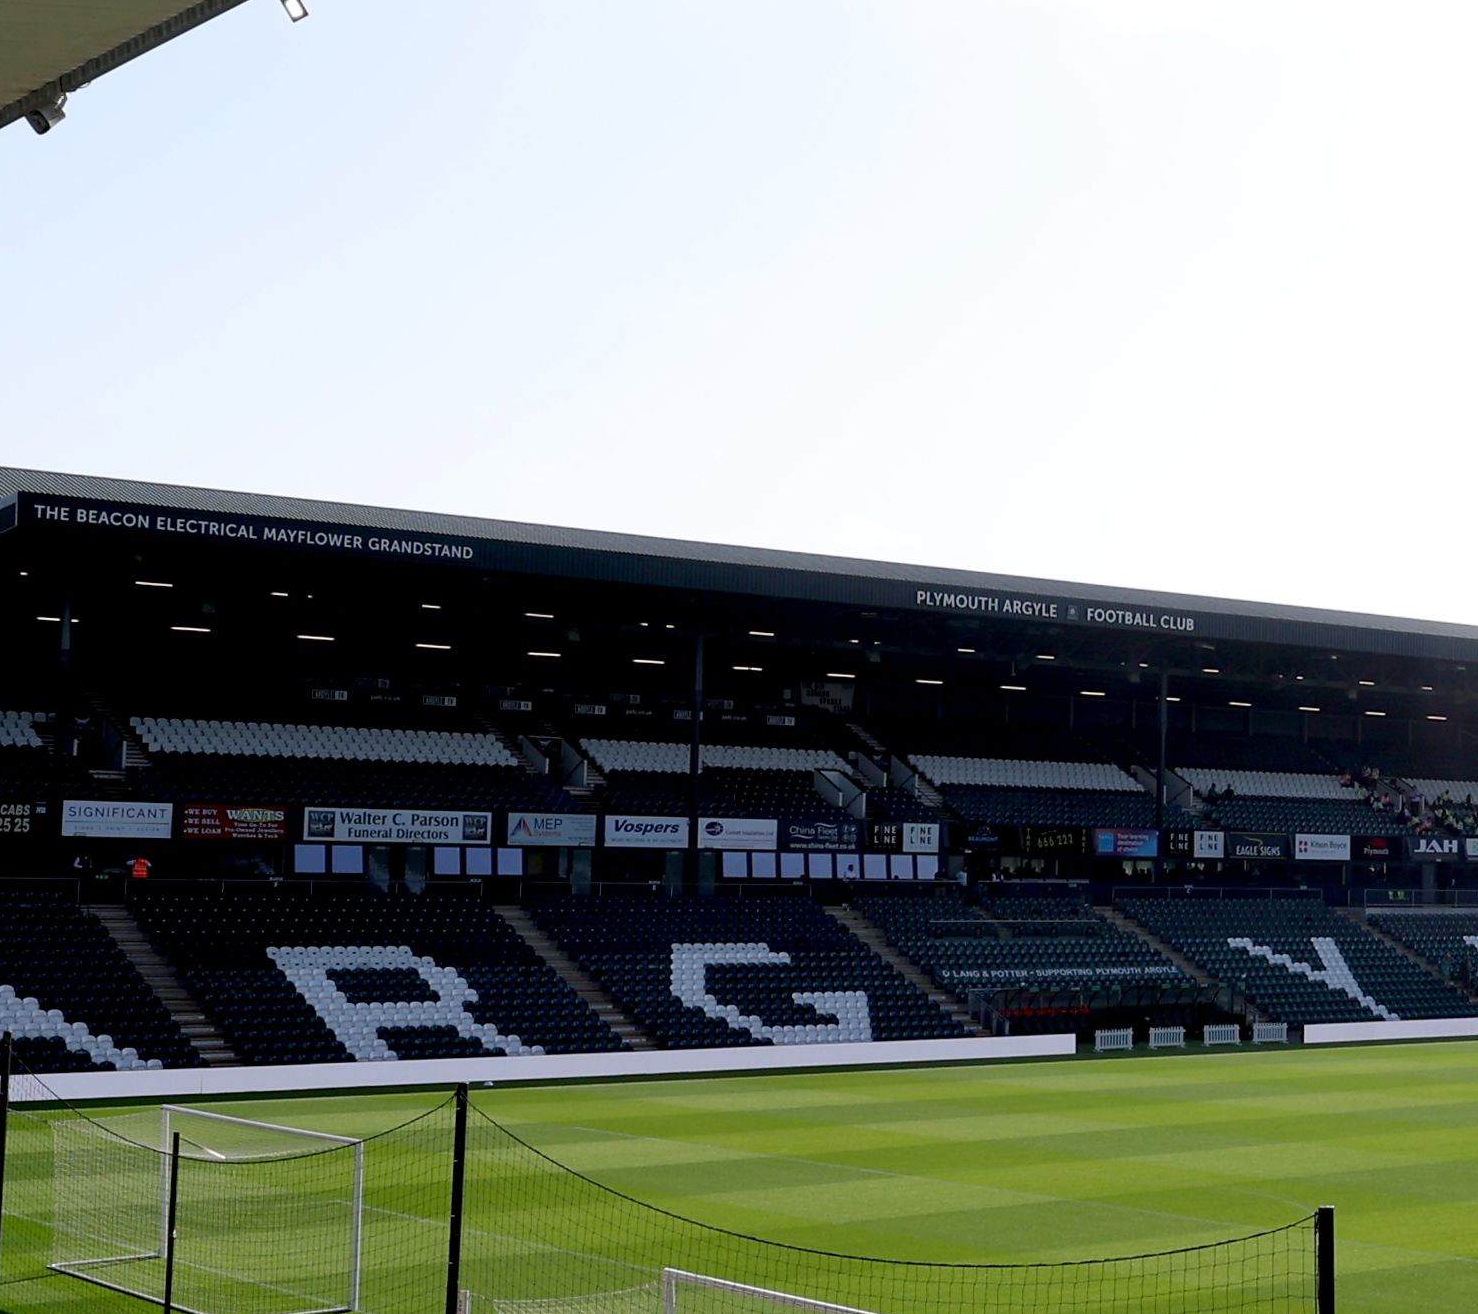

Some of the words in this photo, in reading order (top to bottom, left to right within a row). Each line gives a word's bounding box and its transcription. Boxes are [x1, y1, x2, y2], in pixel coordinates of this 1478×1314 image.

[34, 504, 70, 521] THE
[76, 508, 150, 529] BEACON
[156, 516, 257, 540] ELECTRICAL
[263, 527, 363, 550] MAYFLOWER
[368, 537, 474, 560] GRANDSTAND
[916, 590, 999, 611] PLYMOUTH
[1003, 600, 1058, 618] ARGYLE
[1086, 607, 1156, 628] FOOTBALL
[1160, 616, 1194, 631] CLUB
[0, 803, 31, 816] CABS
[68, 806, 167, 819] SIGNIFICANT
[226, 809, 285, 821] WANTS
[13, 817, 30, 833] 25
[339, 812, 388, 826] Walter
[393, 813, 406, 826] C.
[411, 814, 459, 827] Parson
[534, 818, 562, 830] MEP
[613, 820, 679, 835] Vospers
[789, 825, 816, 835] China
[817, 826, 838, 835] Fleet
[348, 828, 391, 839] Funeral
[396, 828, 449, 840] Directors
[1236, 846, 1258, 856] EAGLE
[1260, 846, 1280, 856] SIGNS
[1311, 841, 1328, 849] Kitson
[1330, 842, 1347, 850] Boyce
[1414, 839, 1458, 853] JAH
[1364, 848, 1389, 856] Plymouth
[953, 970, 979, 978] LANG
[1036, 968, 1092, 976] SUPPORTING
[1095, 967, 1141, 975] PLYMOUTH
[1144, 966, 1177, 974] ARGYLE
